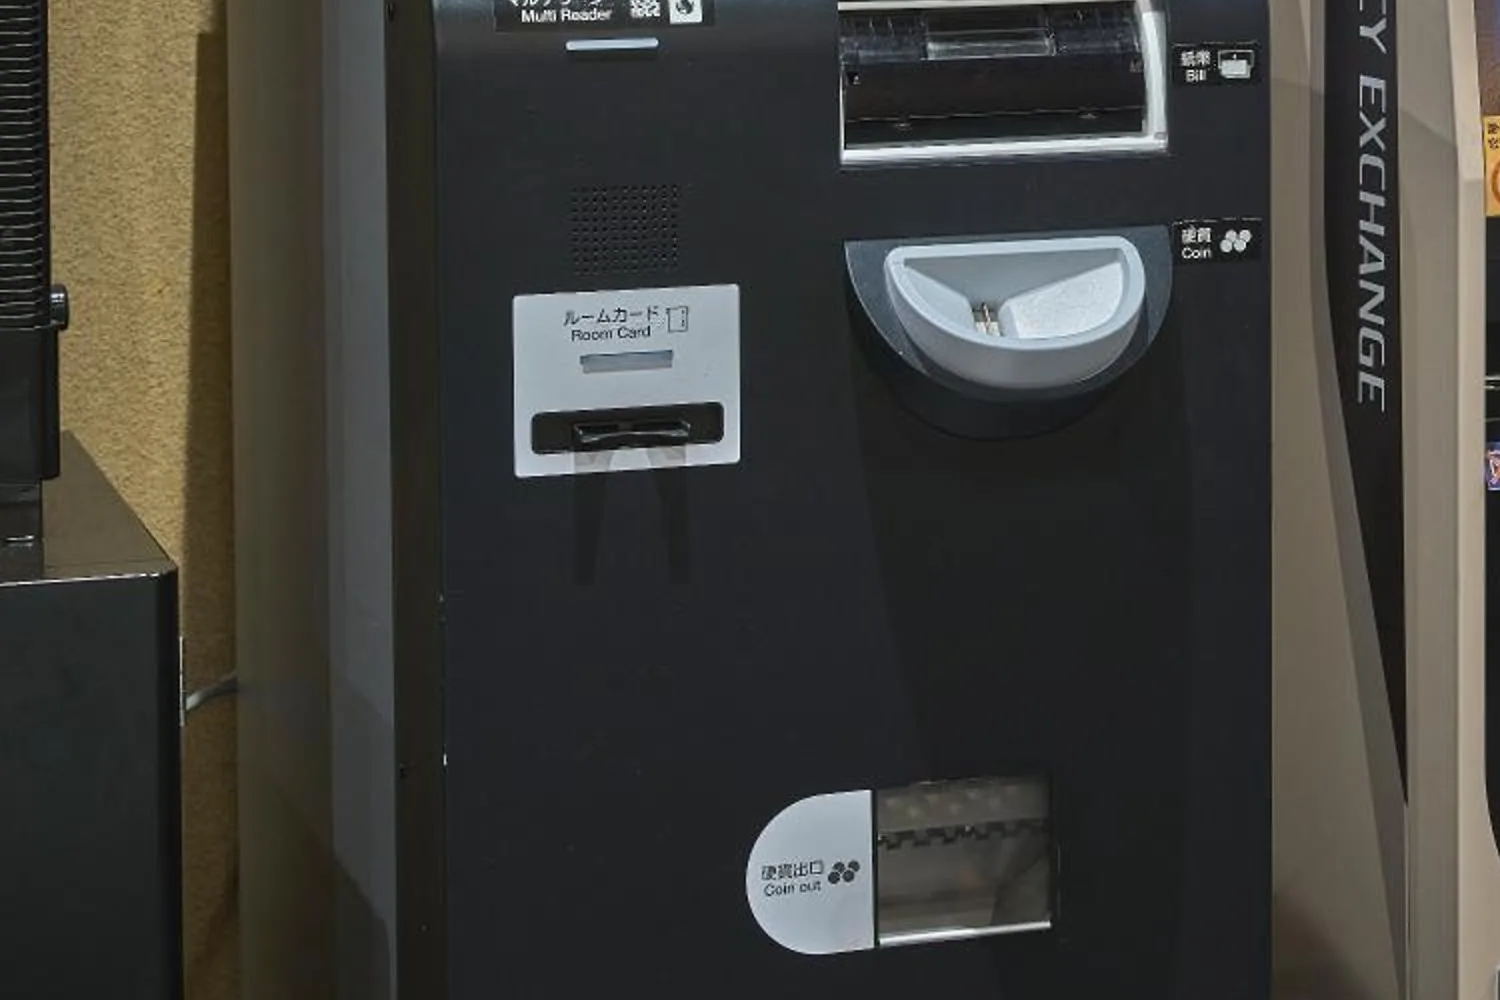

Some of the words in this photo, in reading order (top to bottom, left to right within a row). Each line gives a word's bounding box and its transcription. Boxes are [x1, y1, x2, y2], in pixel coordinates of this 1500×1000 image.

[521, 8, 557, 23] Multi
[561, 7, 613, 22] Reader
[1185, 69, 1207, 82] Bill
[1181, 244, 1212, 259] Coin
[1358, 75, 1387, 411] EXCHANGE
[563, 304, 662, 327] ルームカード
[571, 327, 613, 342] Room
[617, 325, 651, 340] Card
[764, 883, 795, 898] Coin
[799, 881, 822, 894] out
